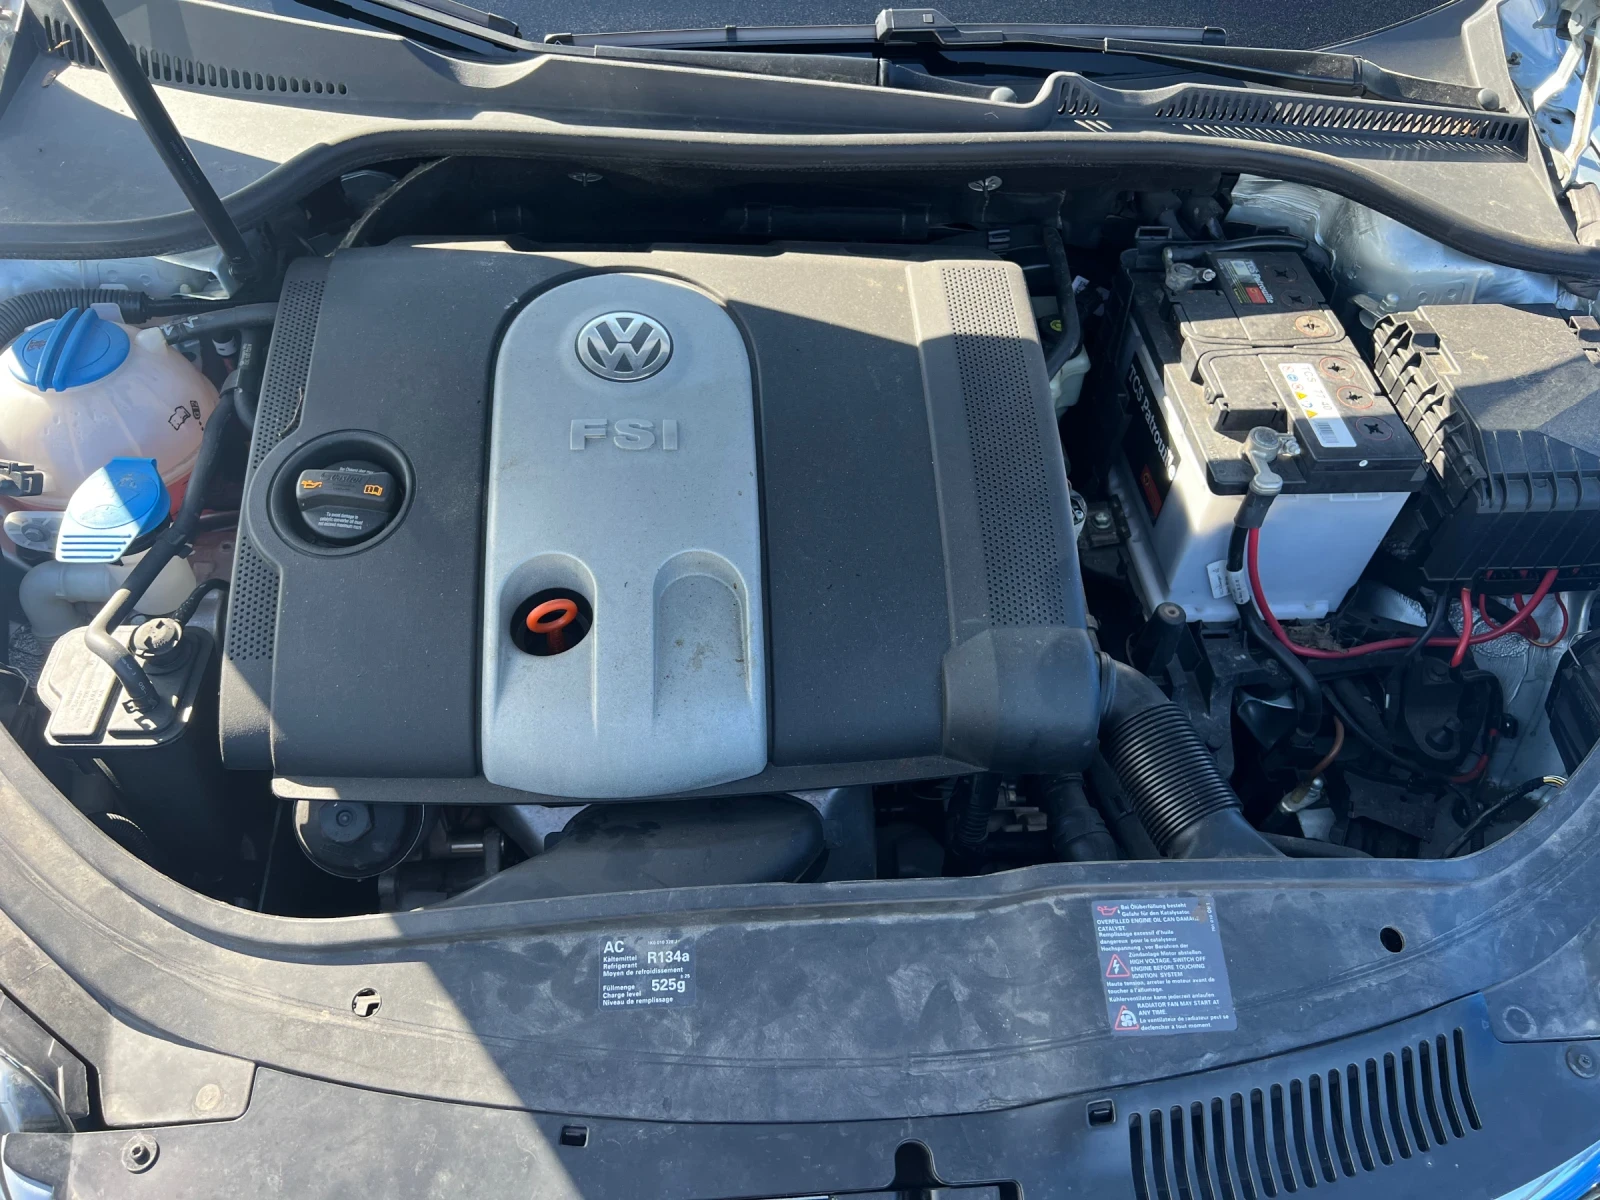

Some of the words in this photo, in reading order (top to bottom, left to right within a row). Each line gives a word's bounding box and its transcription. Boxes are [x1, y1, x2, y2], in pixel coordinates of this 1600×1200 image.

[1251, 273, 1275, 304] Patrouille
[575, 310, 673, 383] VW
[1129, 363, 1144, 402] TCS
[570, 419, 679, 450] FSI
[604, 941, 624, 953] AC
[648, 950, 690, 964] R134a
[636, 967, 683, 975] refroidissement
[652, 978, 685, 992] 525g
